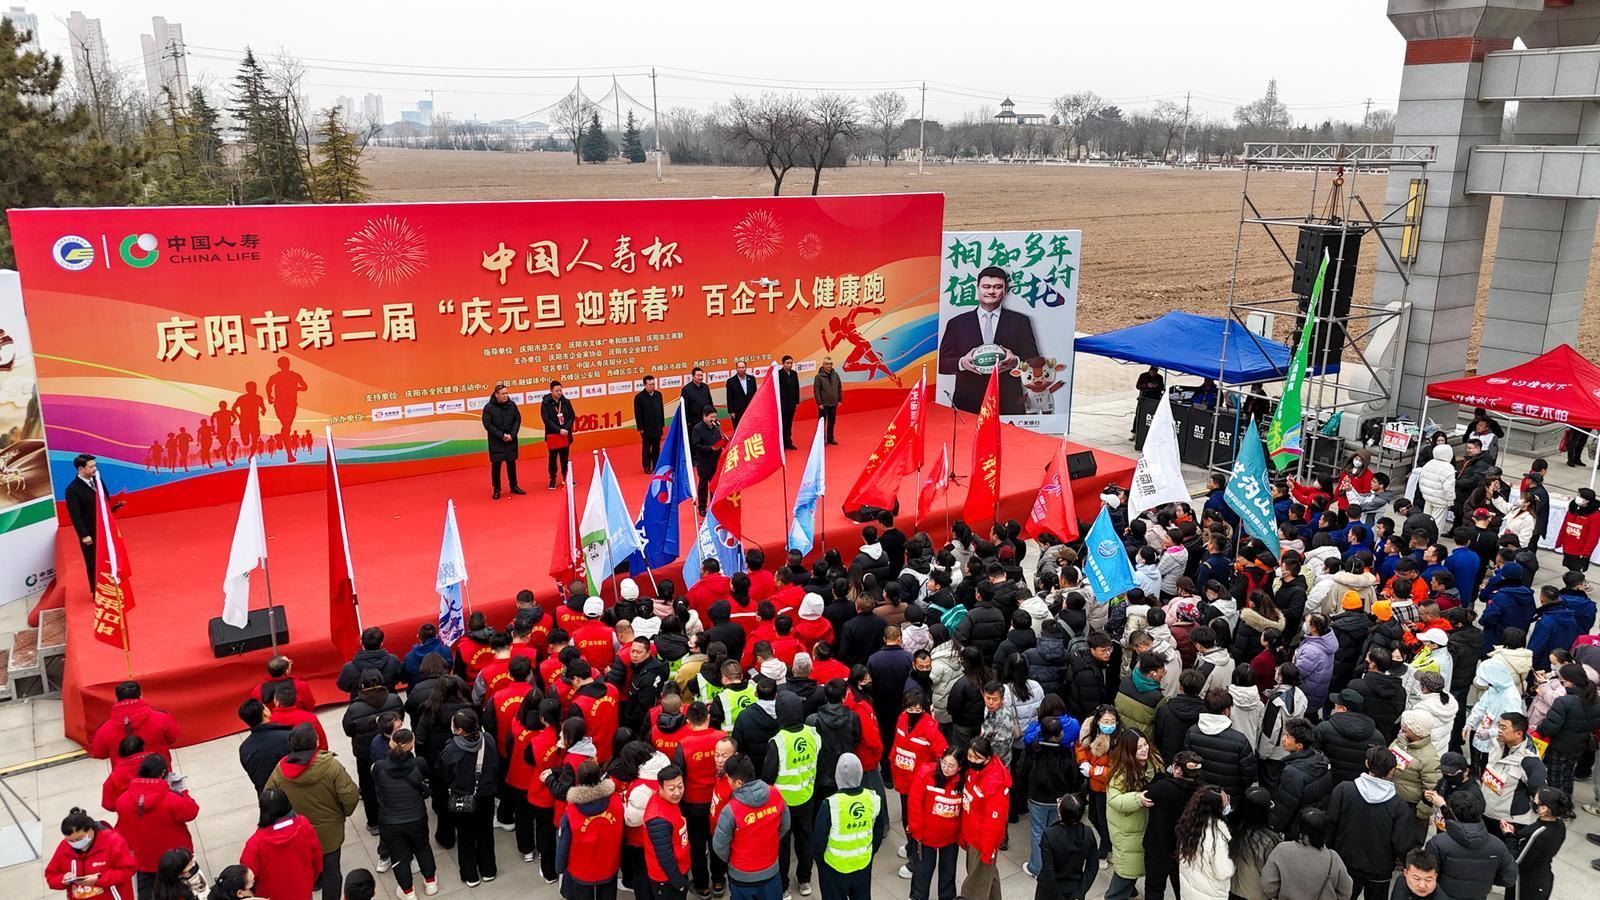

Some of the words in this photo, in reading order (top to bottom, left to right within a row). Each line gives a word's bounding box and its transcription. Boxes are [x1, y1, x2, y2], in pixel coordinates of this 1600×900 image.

[167, 233, 260, 252] 中国人寿
[944, 232, 1072, 269] 相知多年
[169, 253, 221, 264] CHINA
[227, 251, 260, 262] LIFE
[481, 234, 683, 286] 中国人寿杯
[156, 302, 418, 361] 庆阳市第二届
[438, 294, 567, 337] “庆元旦
[575, 284, 685, 327] 迎新春”
[701, 272, 886, 317] 百企千人健康跑
[573, 410, 622, 432] 026.1.1
